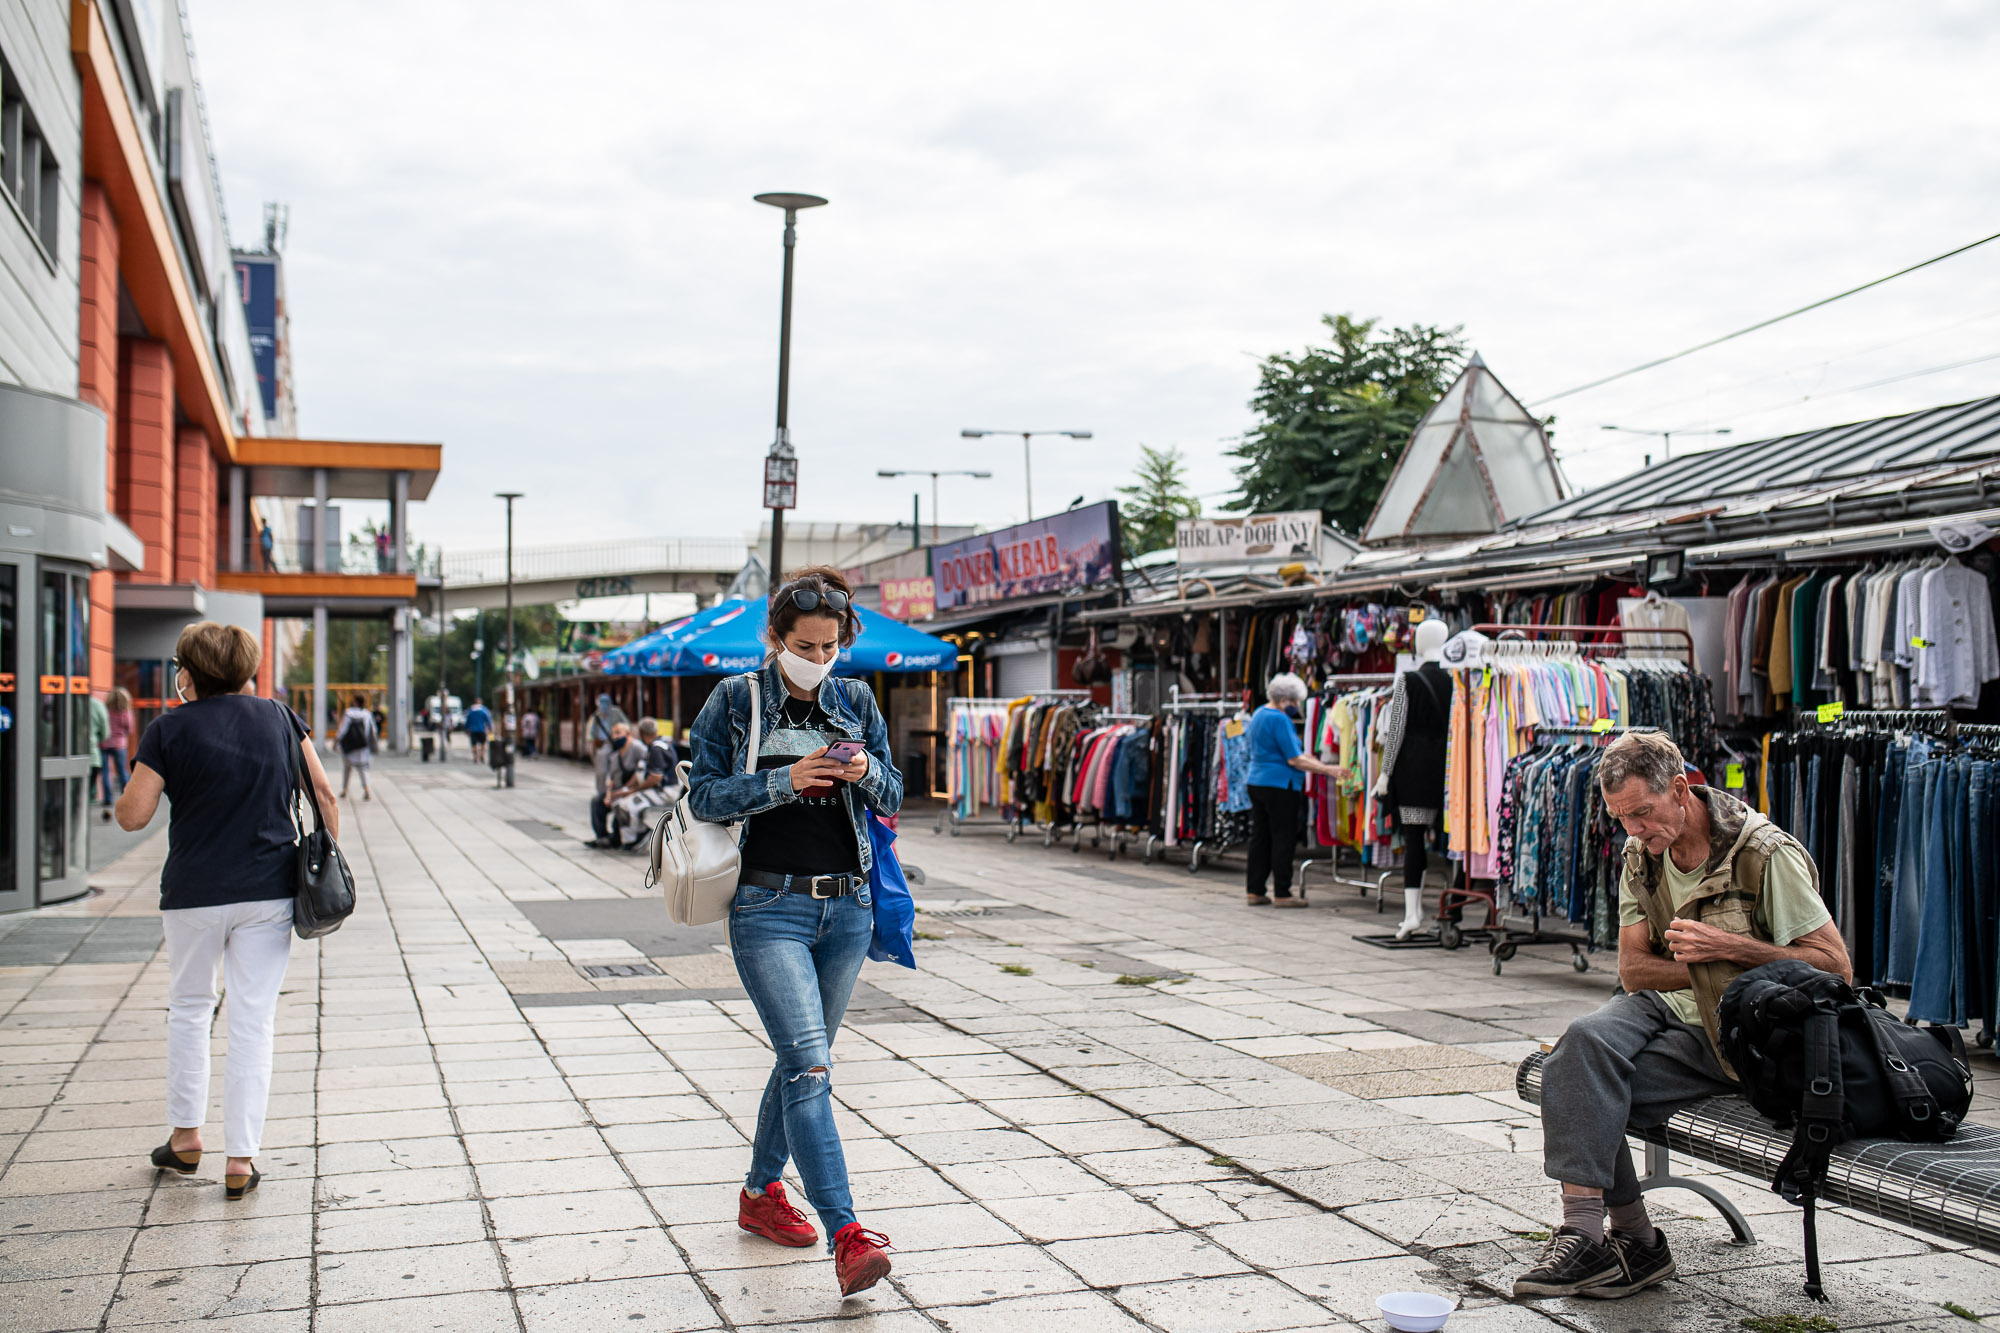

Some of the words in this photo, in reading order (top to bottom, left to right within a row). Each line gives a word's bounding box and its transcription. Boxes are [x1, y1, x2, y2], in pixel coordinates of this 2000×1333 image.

[941, 547, 995, 593] DÖNER
[1000, 534, 1060, 581] KEBAB
[721, 656, 760, 669] pepsi
[904, 654, 941, 668] pepsi
